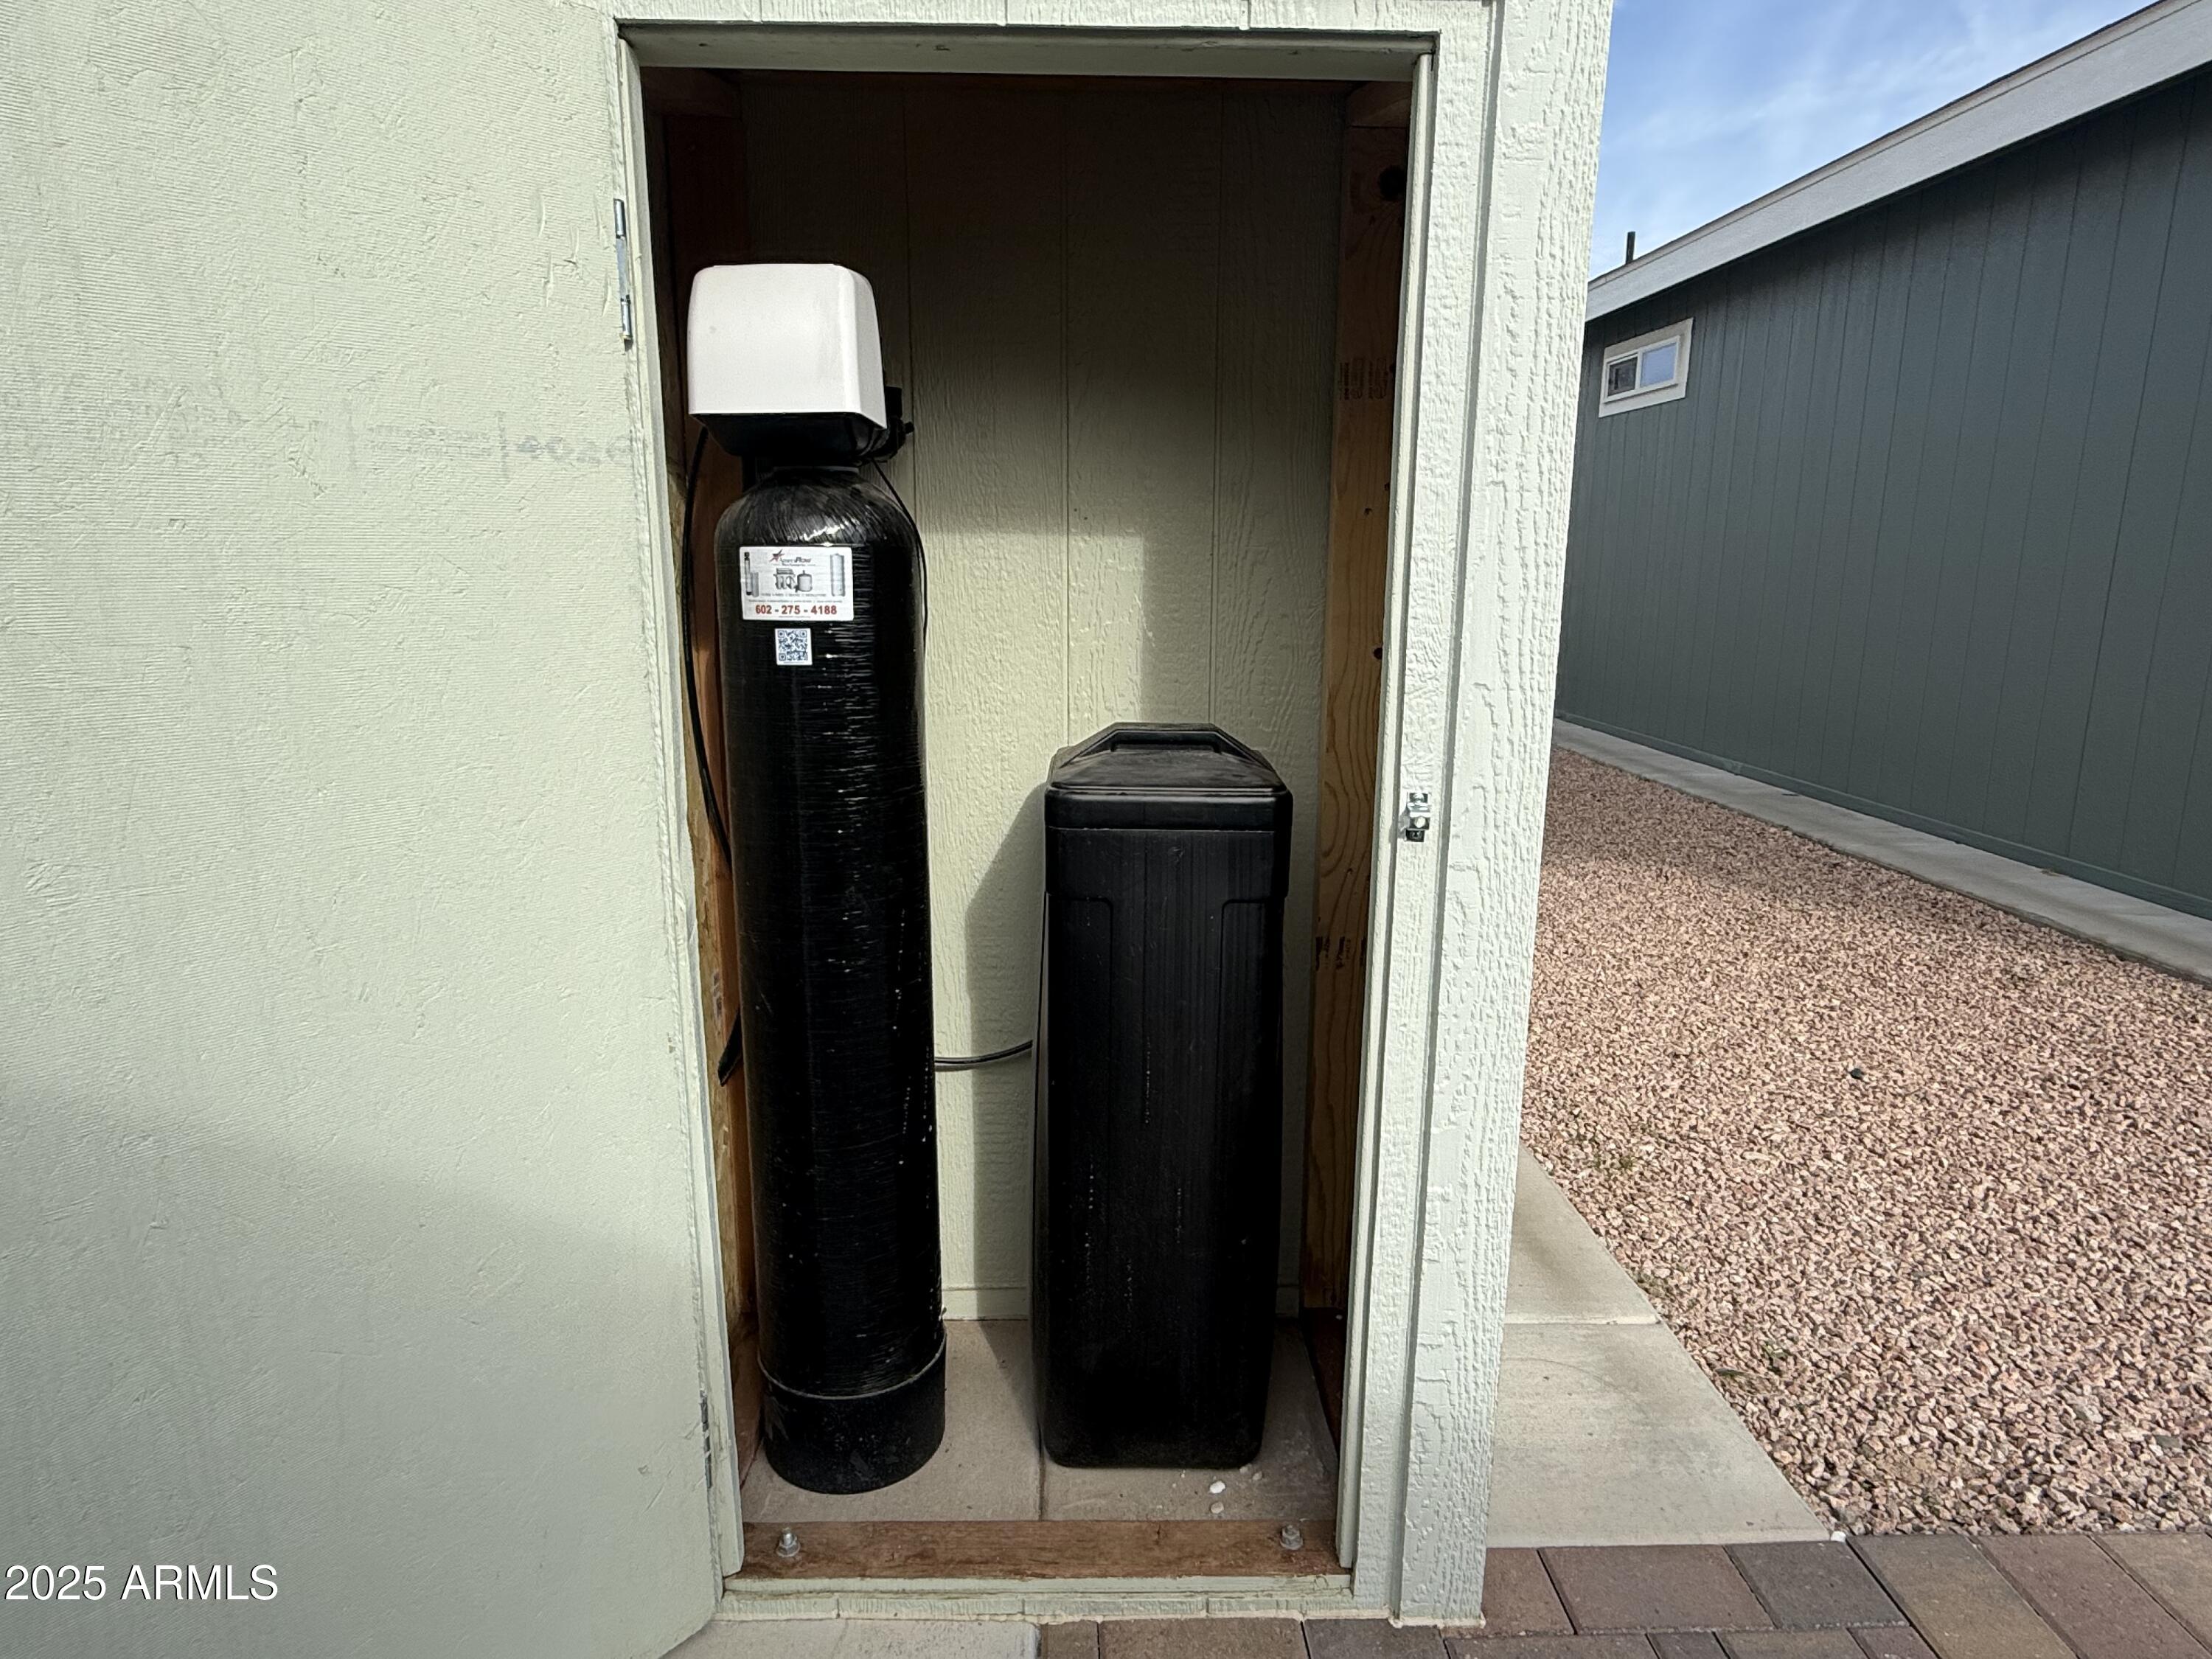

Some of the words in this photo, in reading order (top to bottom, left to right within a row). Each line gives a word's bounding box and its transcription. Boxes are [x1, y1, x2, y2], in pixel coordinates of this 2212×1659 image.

[756, 605, 772, 614] 602
[782, 605, 800, 614] 275
[811, 605, 837, 615] 4188
